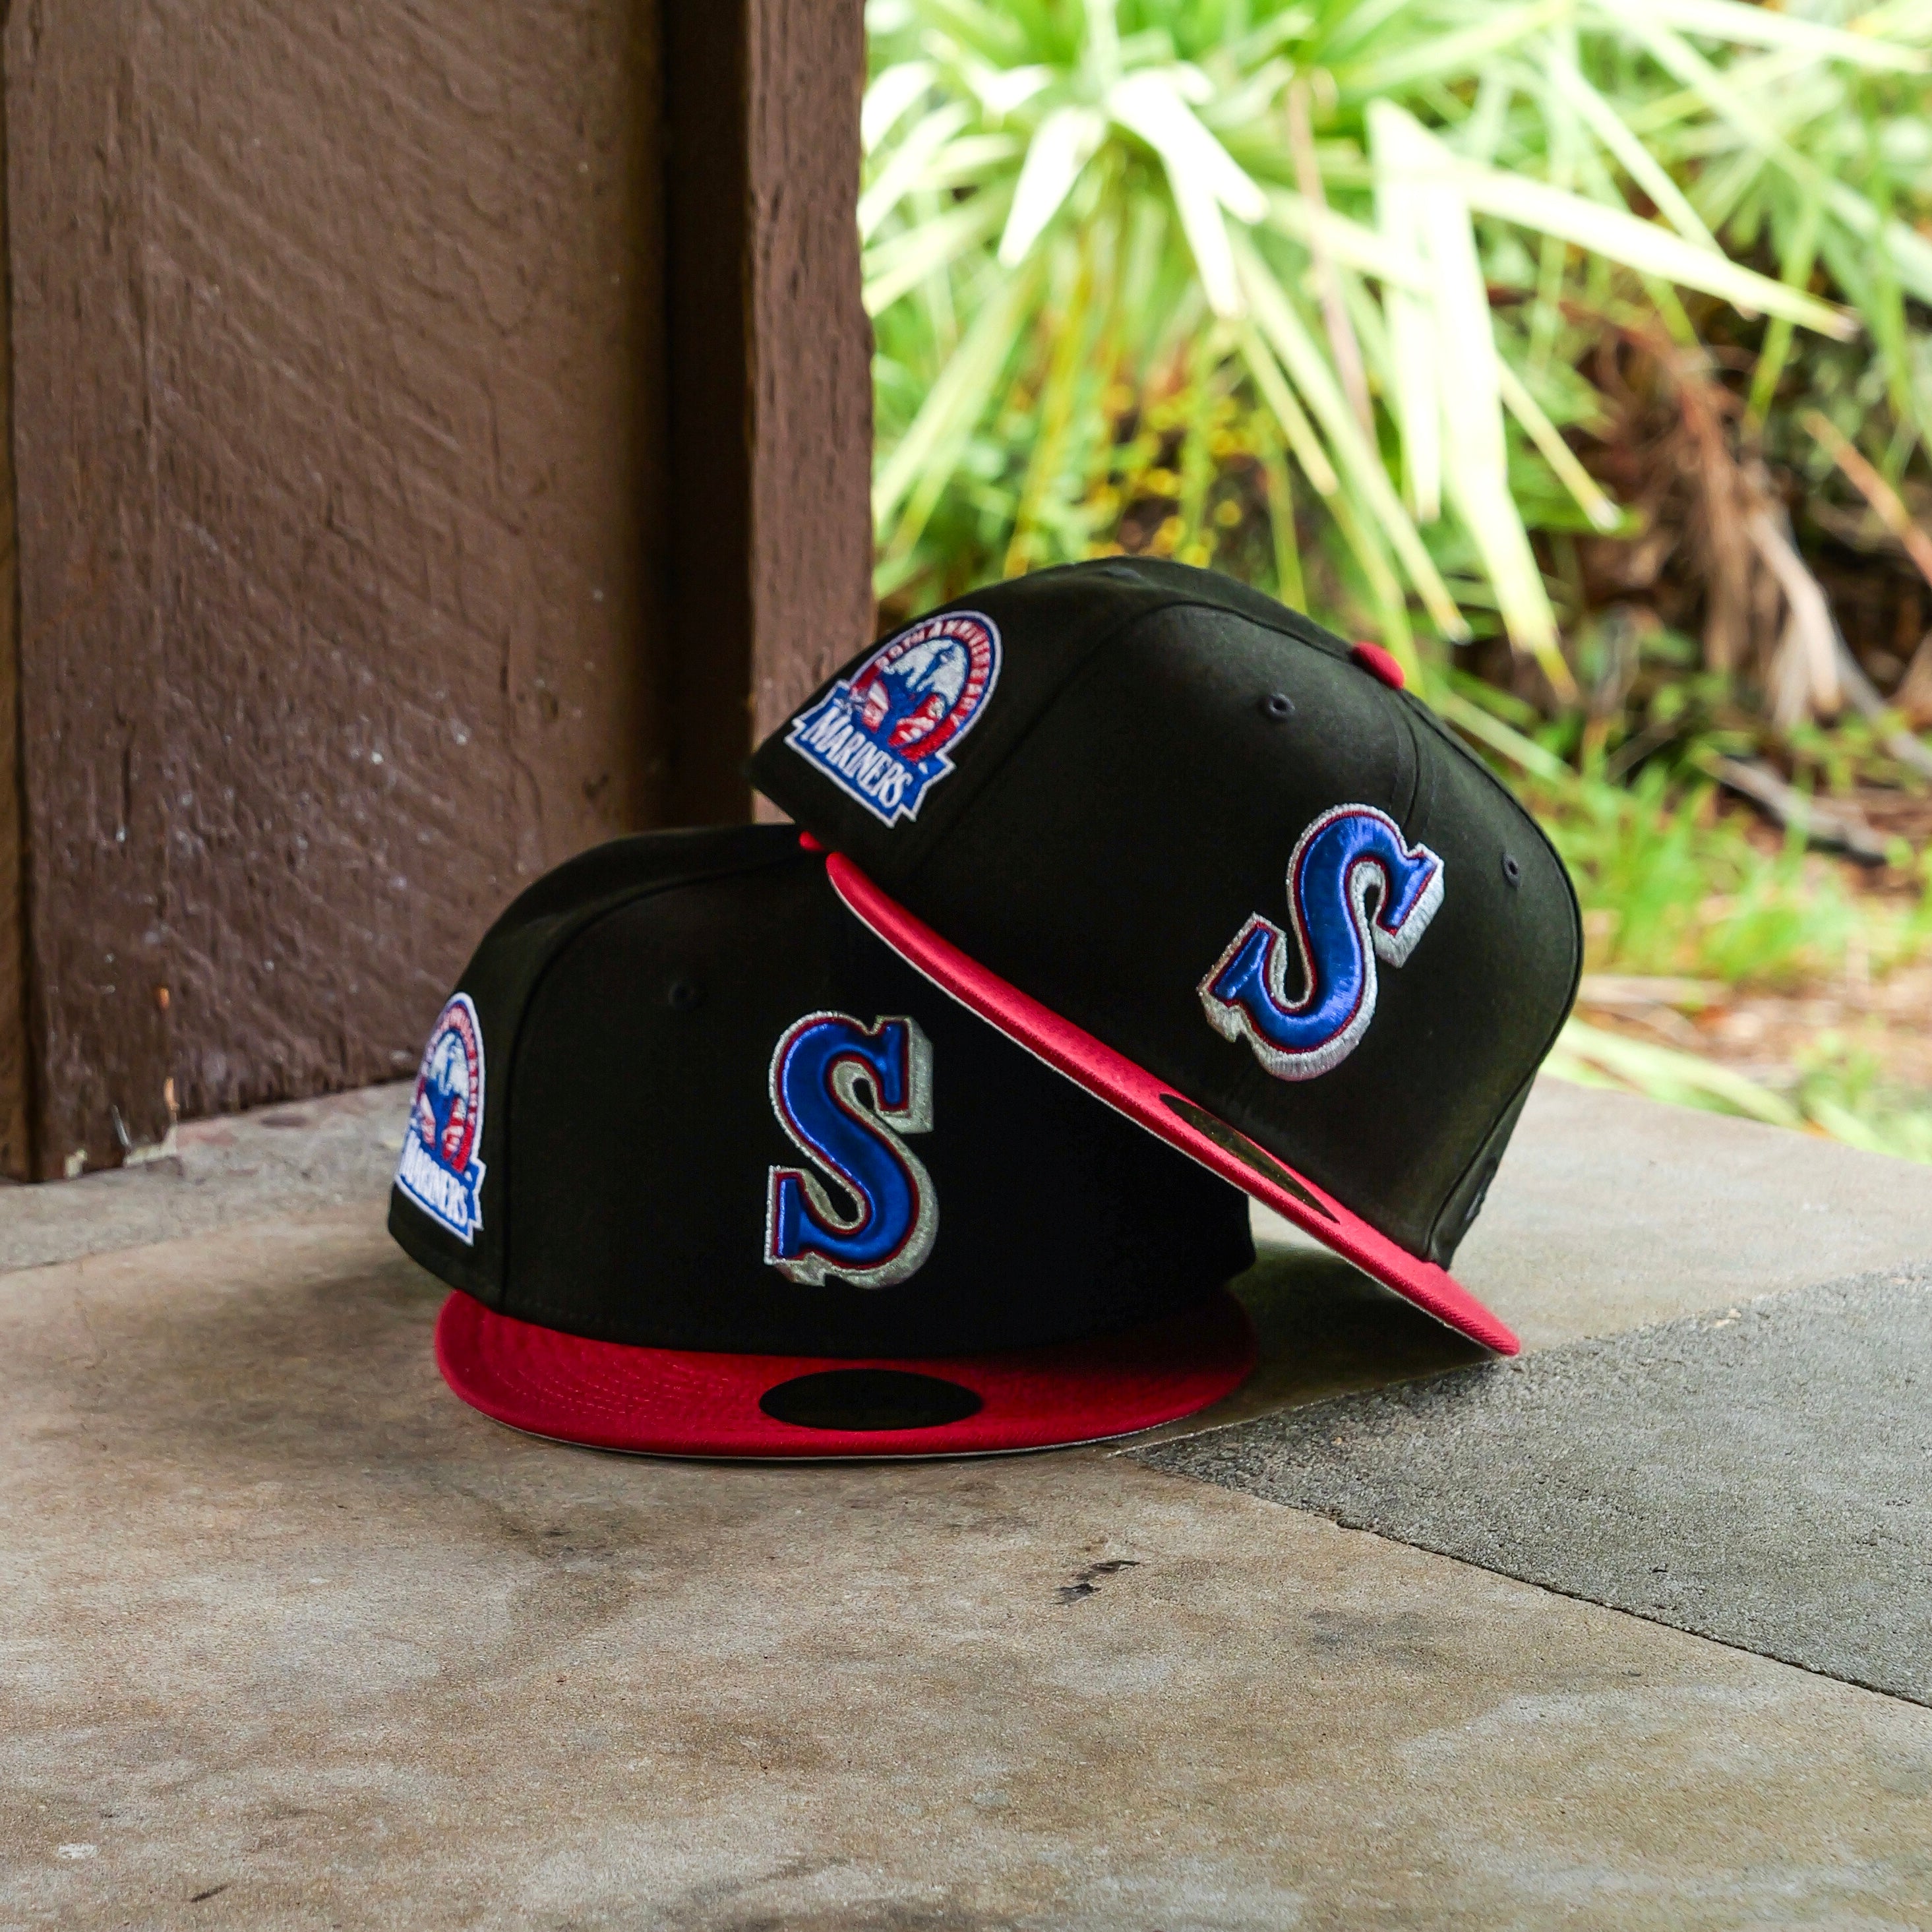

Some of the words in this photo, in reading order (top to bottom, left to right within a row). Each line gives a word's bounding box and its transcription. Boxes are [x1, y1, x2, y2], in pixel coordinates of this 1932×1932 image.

[799, 706, 913, 808] MARINERS
[1197, 803, 1445, 1081] S
[764, 1010, 938, 1287] S
